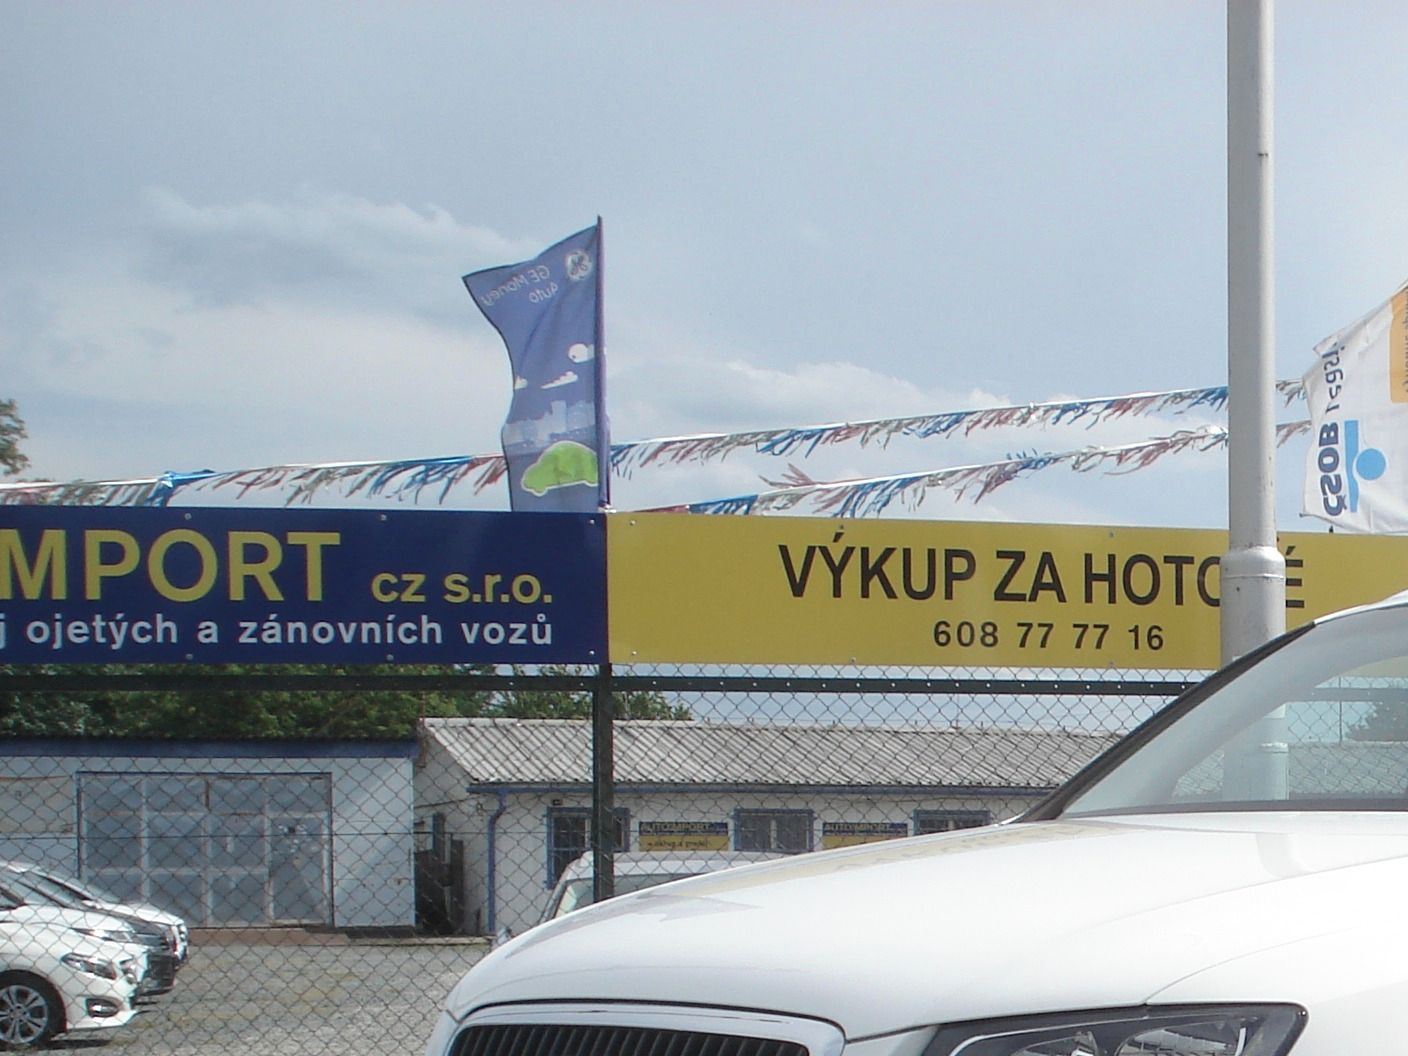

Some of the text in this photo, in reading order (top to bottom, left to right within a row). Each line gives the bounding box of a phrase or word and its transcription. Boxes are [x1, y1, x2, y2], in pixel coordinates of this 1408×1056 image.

[0, 528, 552, 603] MPORT cz s.r.o.
[778, 530, 1305, 610] VÝKUP ZA HOTOÉ
[26, 612, 178, 650] ojetých
[198, 620, 218, 643] a
[239, 614, 442, 645] zánovních
[461, 614, 552, 645] vozů
[934, 620, 1164, 650] 608 77 77 16
